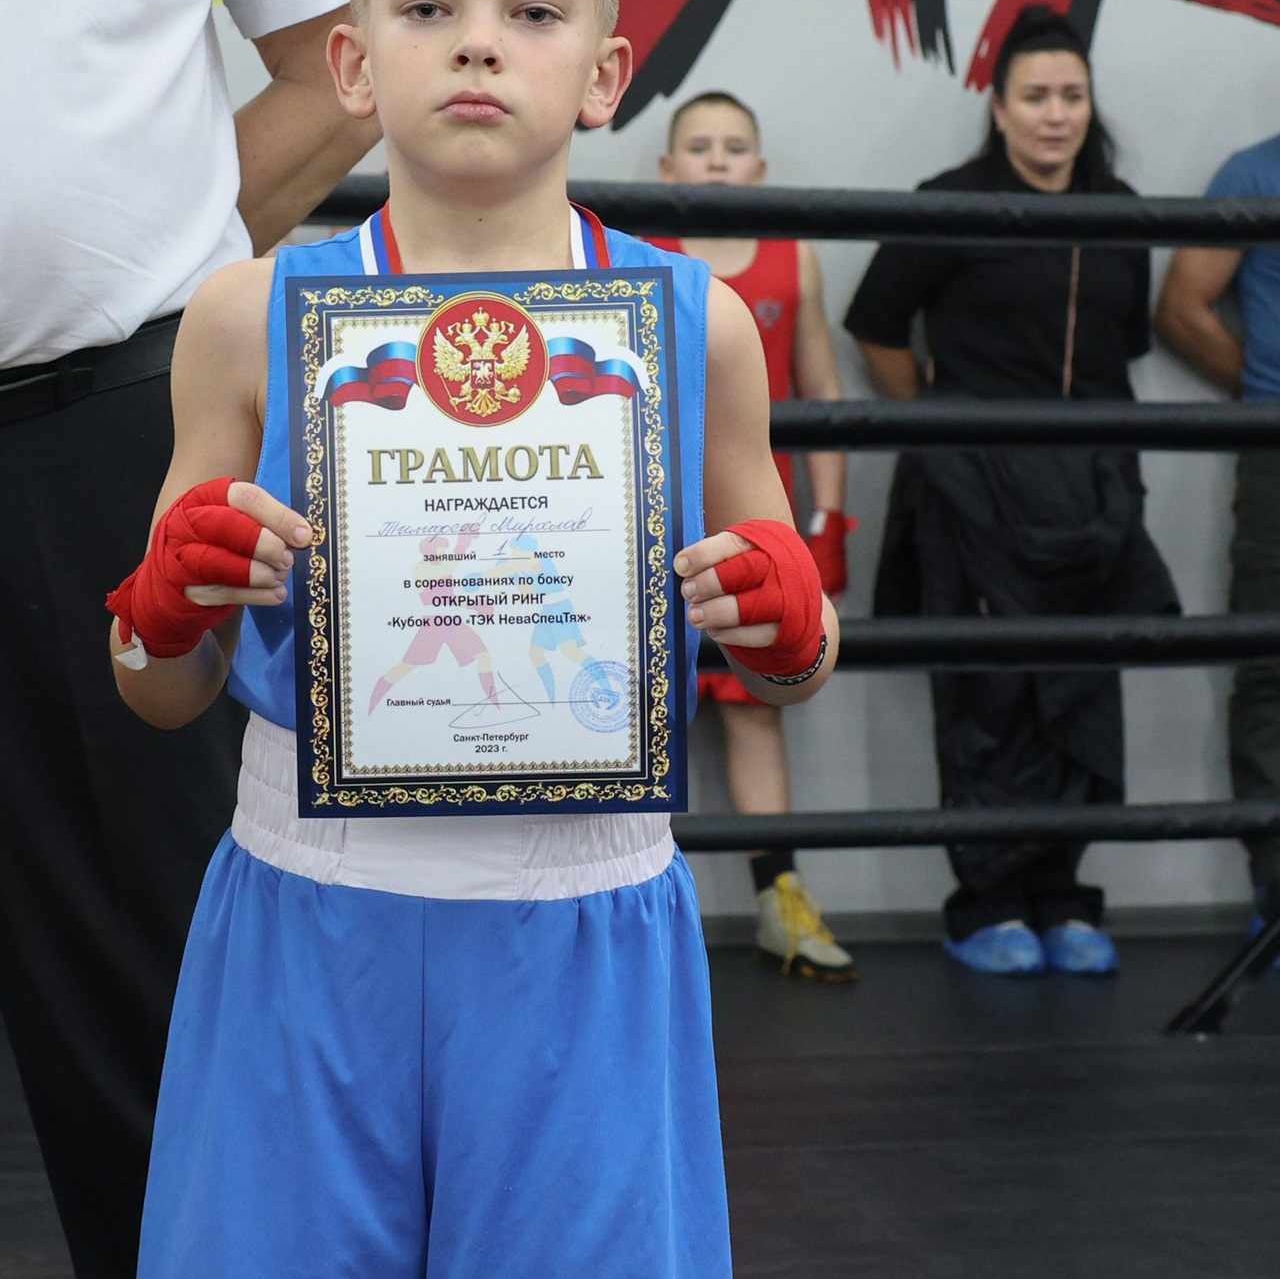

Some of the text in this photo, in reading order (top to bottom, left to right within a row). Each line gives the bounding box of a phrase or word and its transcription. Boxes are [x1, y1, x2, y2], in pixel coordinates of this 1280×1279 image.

[367, 444, 604, 485] ГРАМОТА
[424, 495, 548, 512] НАГРАЖДАЕТСЯ
[423, 539, 565, 562] занявший 1 место
[403, 573, 574, 590] в соревнованиях по боксу
[432, 592, 546, 607] ОТКРЫТЫЙ РИНГ
[434, 615, 462, 626] ООО
[499, 612, 592, 625] НеваСпецТяж»
[386, 697, 451, 708] Главный судья
[453, 732, 529, 744] Санкт-Петербург
[475, 745, 500, 753] 2023
